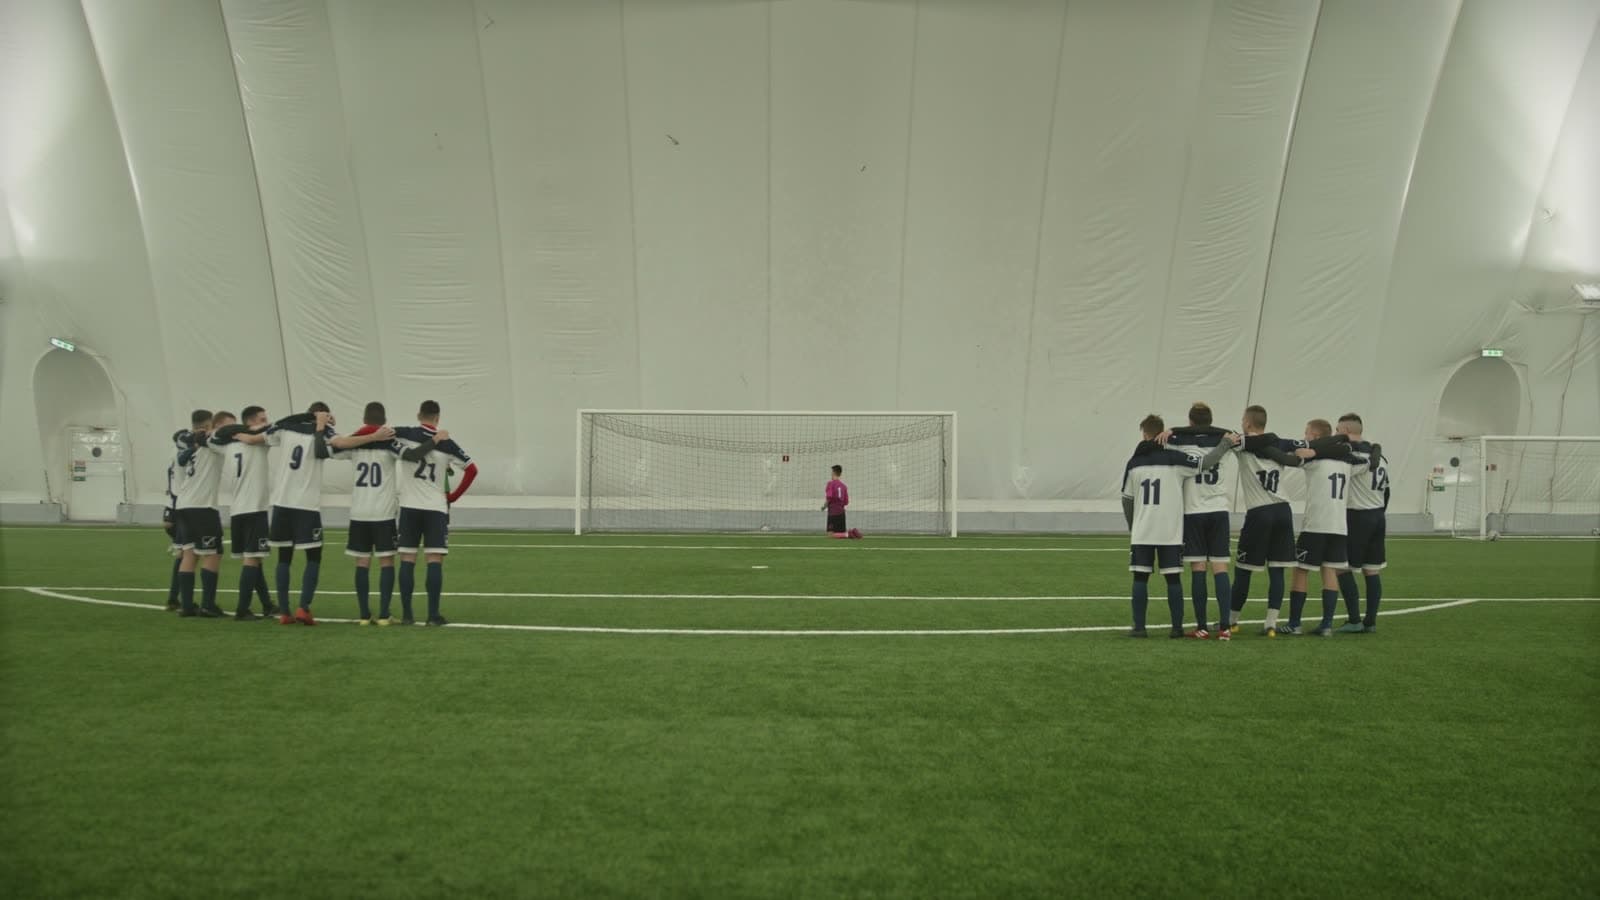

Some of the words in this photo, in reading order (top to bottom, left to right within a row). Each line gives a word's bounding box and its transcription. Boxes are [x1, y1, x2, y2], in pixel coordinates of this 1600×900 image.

[289, 444, 303, 470] 9
[413, 457, 436, 482] 21
[355, 461, 382, 487] 20
[1256, 469, 1280, 494] 10
[1328, 472, 1346, 500] 17
[1370, 466, 1388, 491] 12
[1140, 478, 1161, 505] 11
